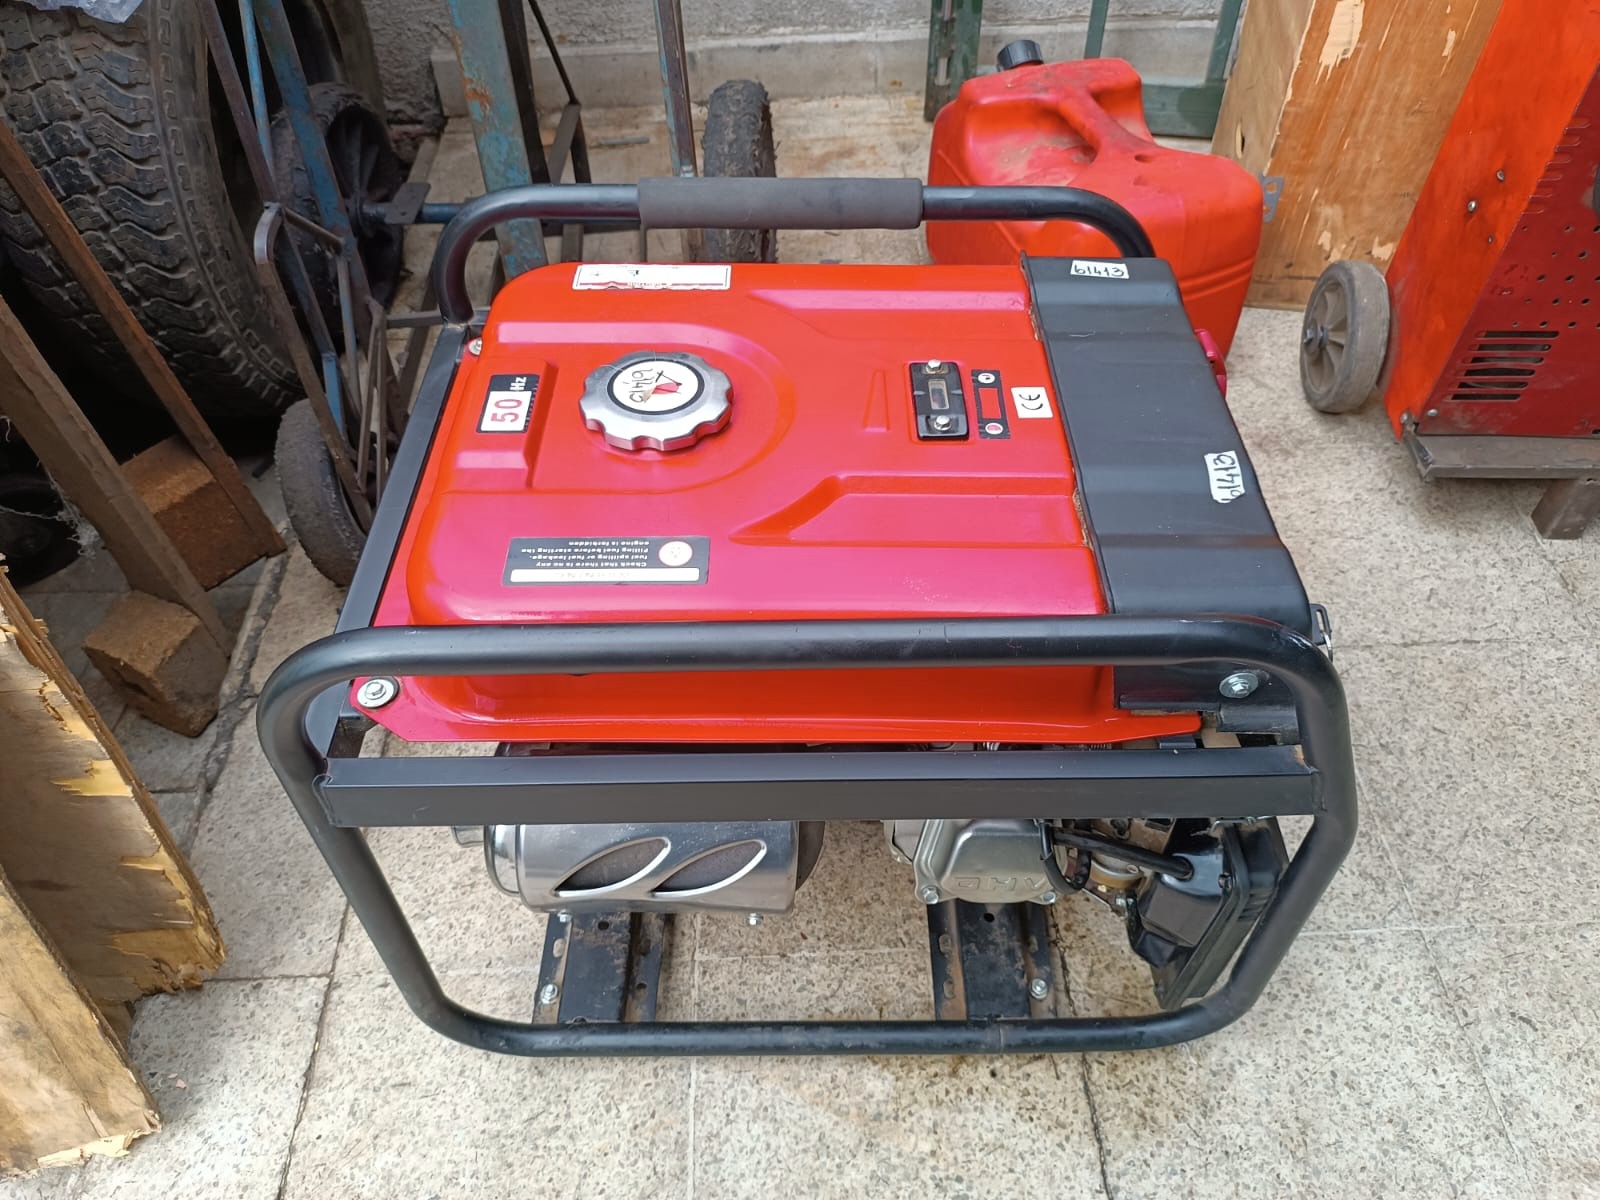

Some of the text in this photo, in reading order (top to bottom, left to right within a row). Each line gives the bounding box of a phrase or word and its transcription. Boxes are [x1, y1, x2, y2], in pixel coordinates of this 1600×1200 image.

[1074, 264, 1125, 277] 61413
[490, 376, 527, 423] 50 Hz
